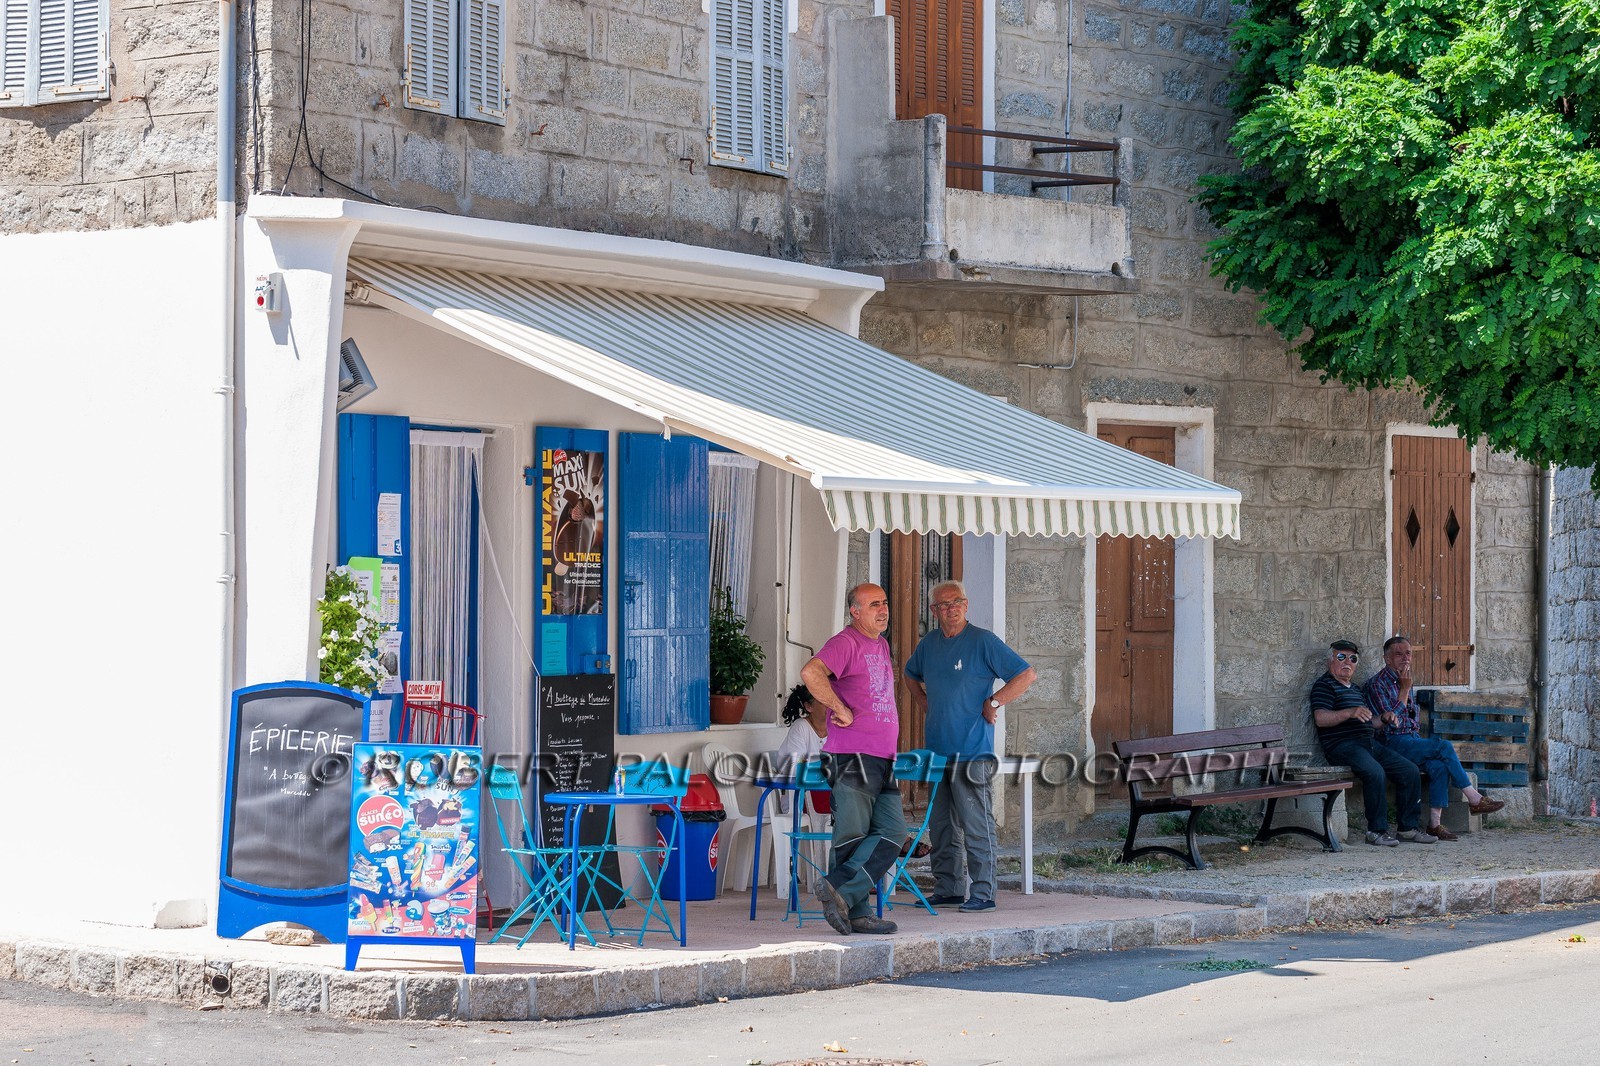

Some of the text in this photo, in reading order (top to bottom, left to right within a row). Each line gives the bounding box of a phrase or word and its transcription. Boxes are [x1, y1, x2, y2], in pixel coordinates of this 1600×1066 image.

[408, 682, 441, 695] CORSE-MATIN
[361, 808, 379, 817] GLACES
[407, 830, 455, 840] ULTIMATE
